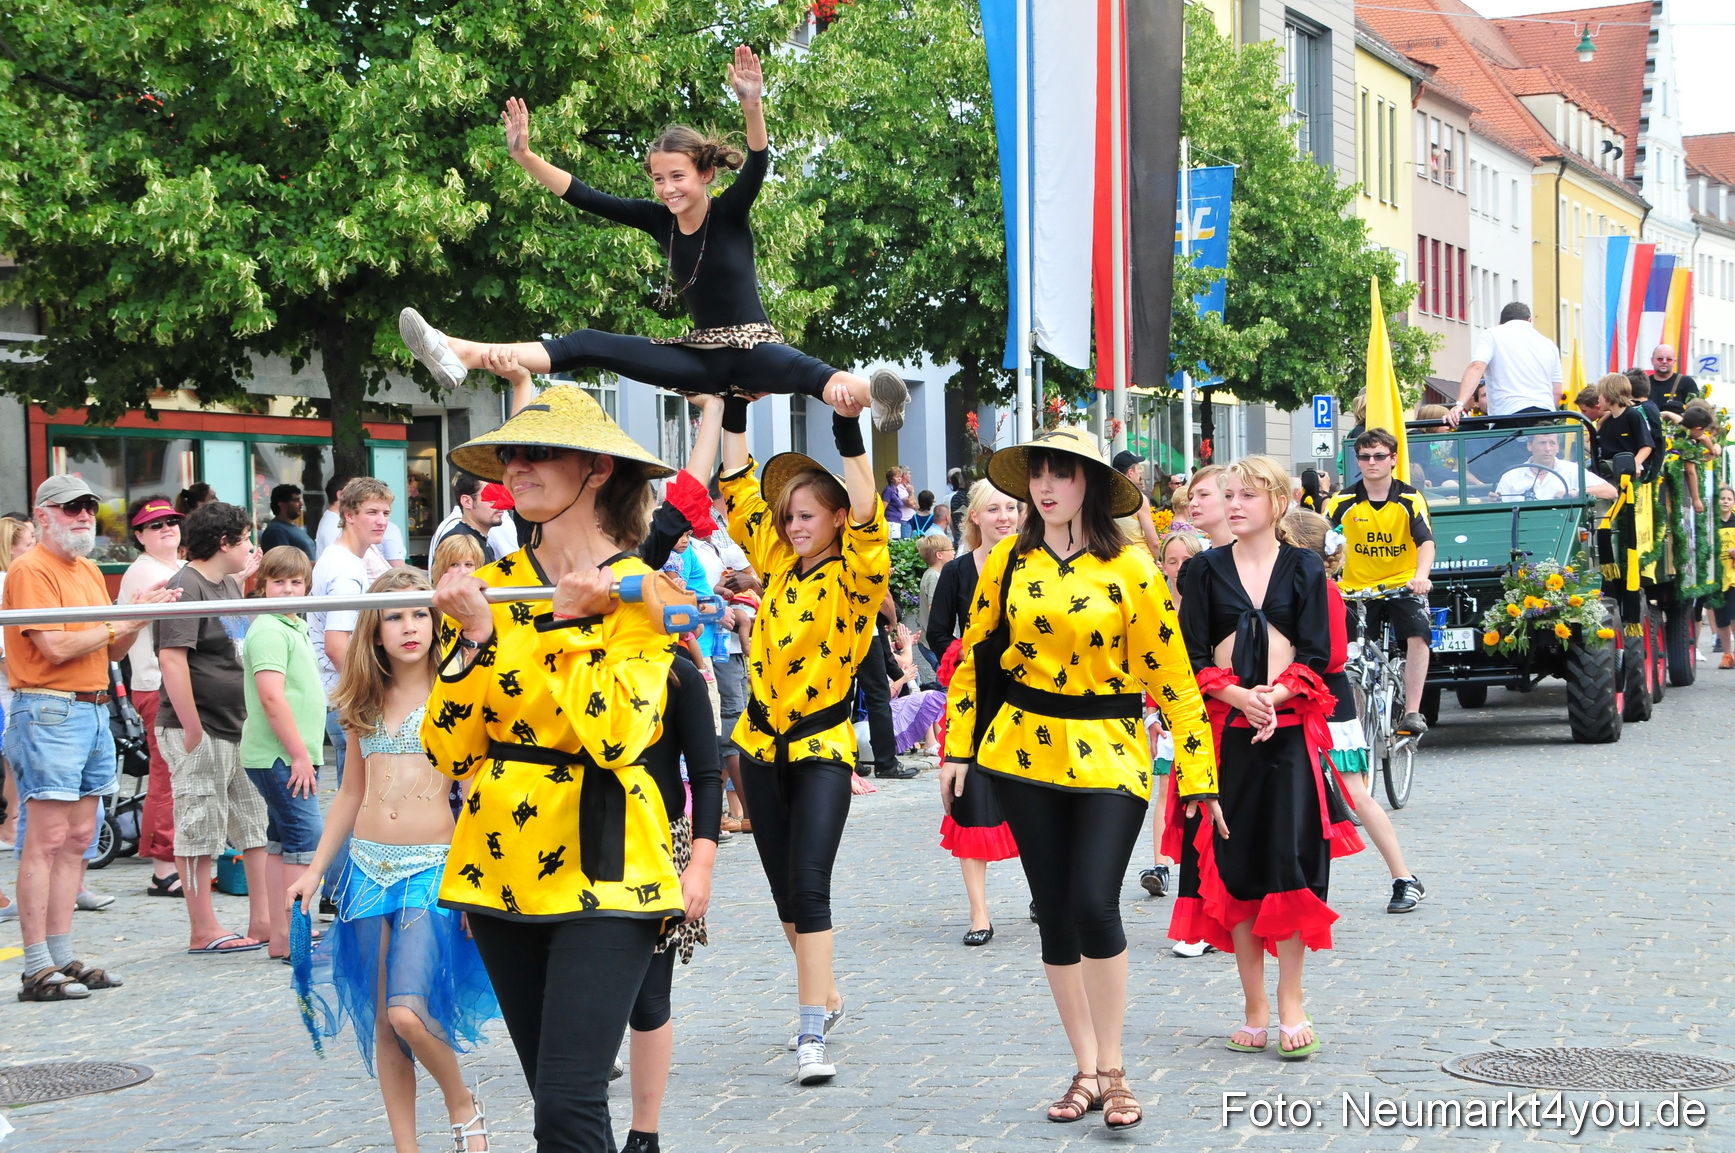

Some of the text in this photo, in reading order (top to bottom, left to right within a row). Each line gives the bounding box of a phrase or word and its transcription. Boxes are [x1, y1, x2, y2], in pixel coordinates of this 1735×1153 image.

[1317, 399, 1328, 425] P
[1366, 531, 1393, 543] BAU
[1354, 543, 1407, 558] GÄRTNER
[1430, 558, 1489, 570] UNIMOG
[1448, 640, 1468, 651] 411
